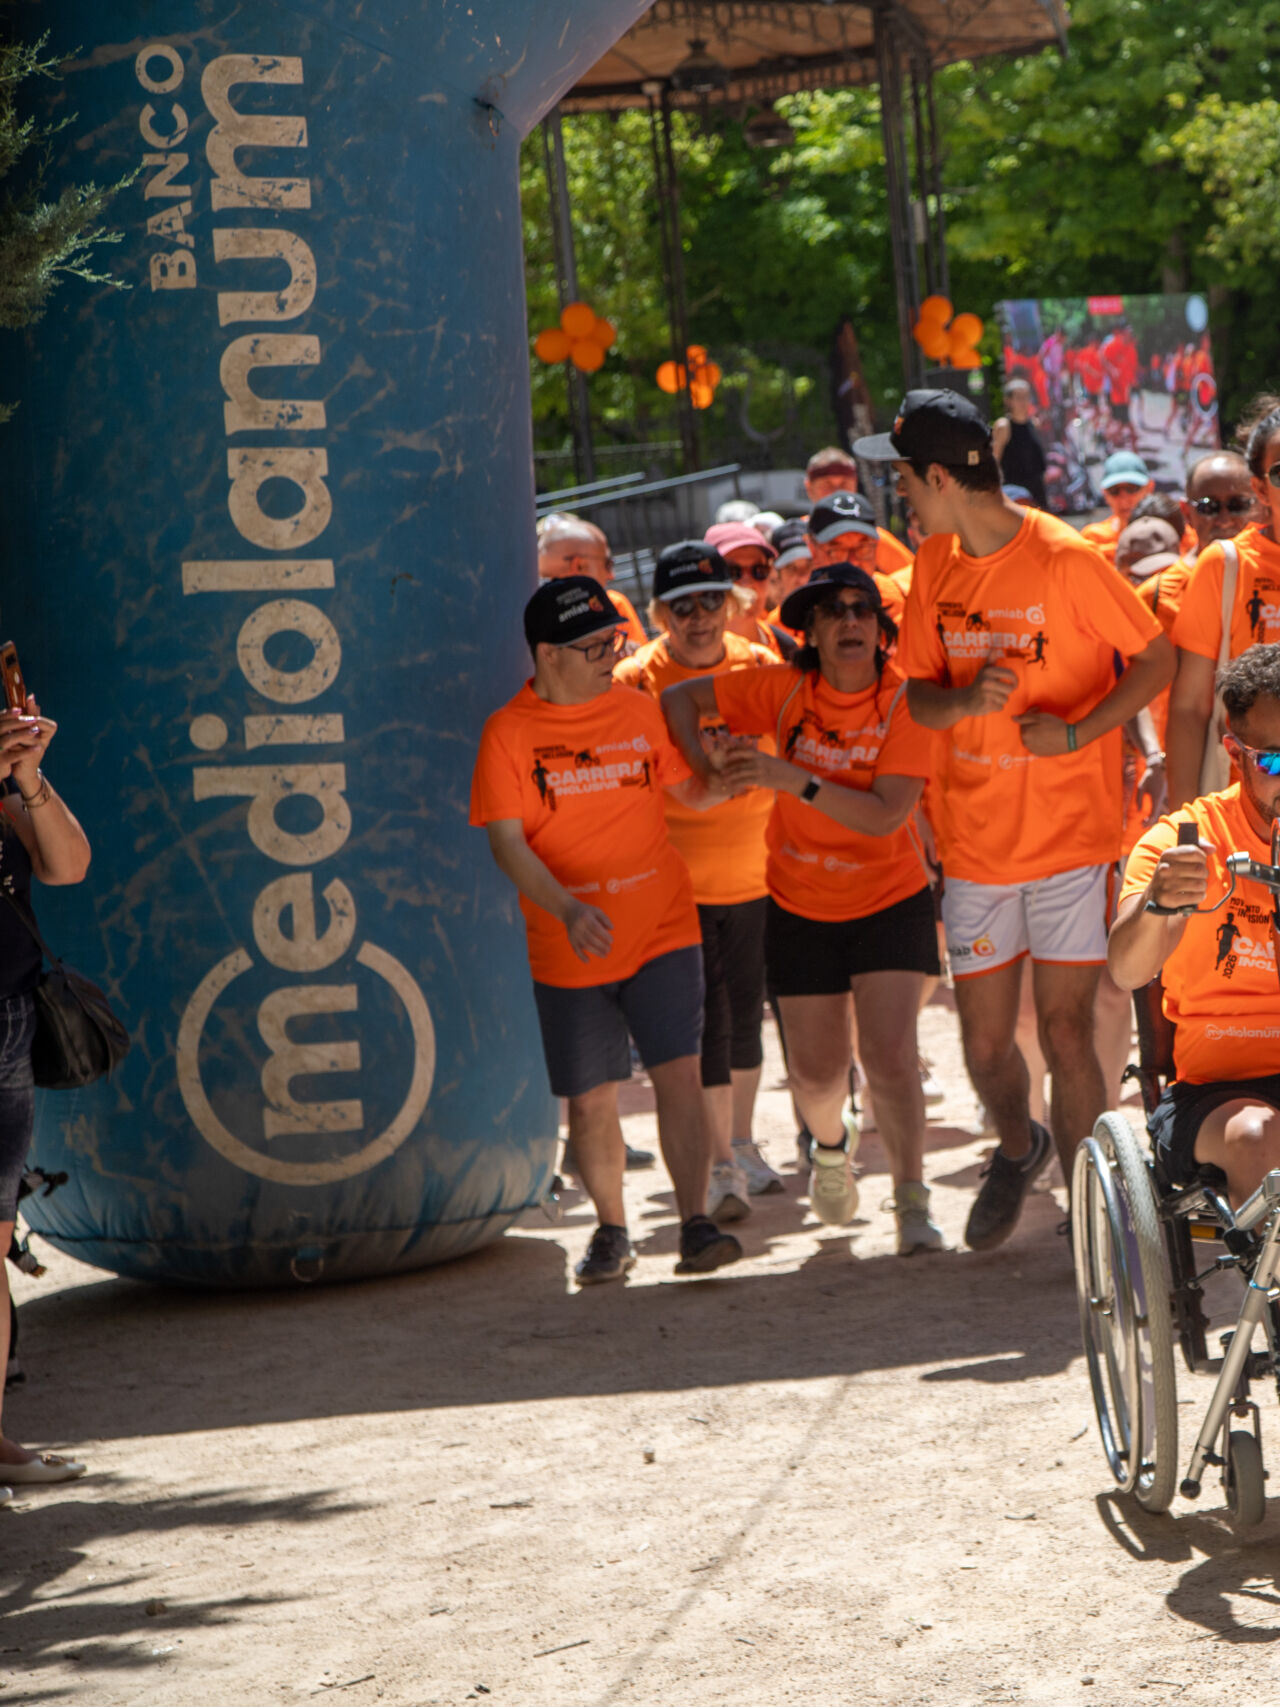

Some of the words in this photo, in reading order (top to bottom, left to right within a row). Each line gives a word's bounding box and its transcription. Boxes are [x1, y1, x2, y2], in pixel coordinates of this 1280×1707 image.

[136, 43, 197, 291] BANCO
[181, 53, 365, 1140] mediolanum
[546, 760, 643, 787] CARRERA
